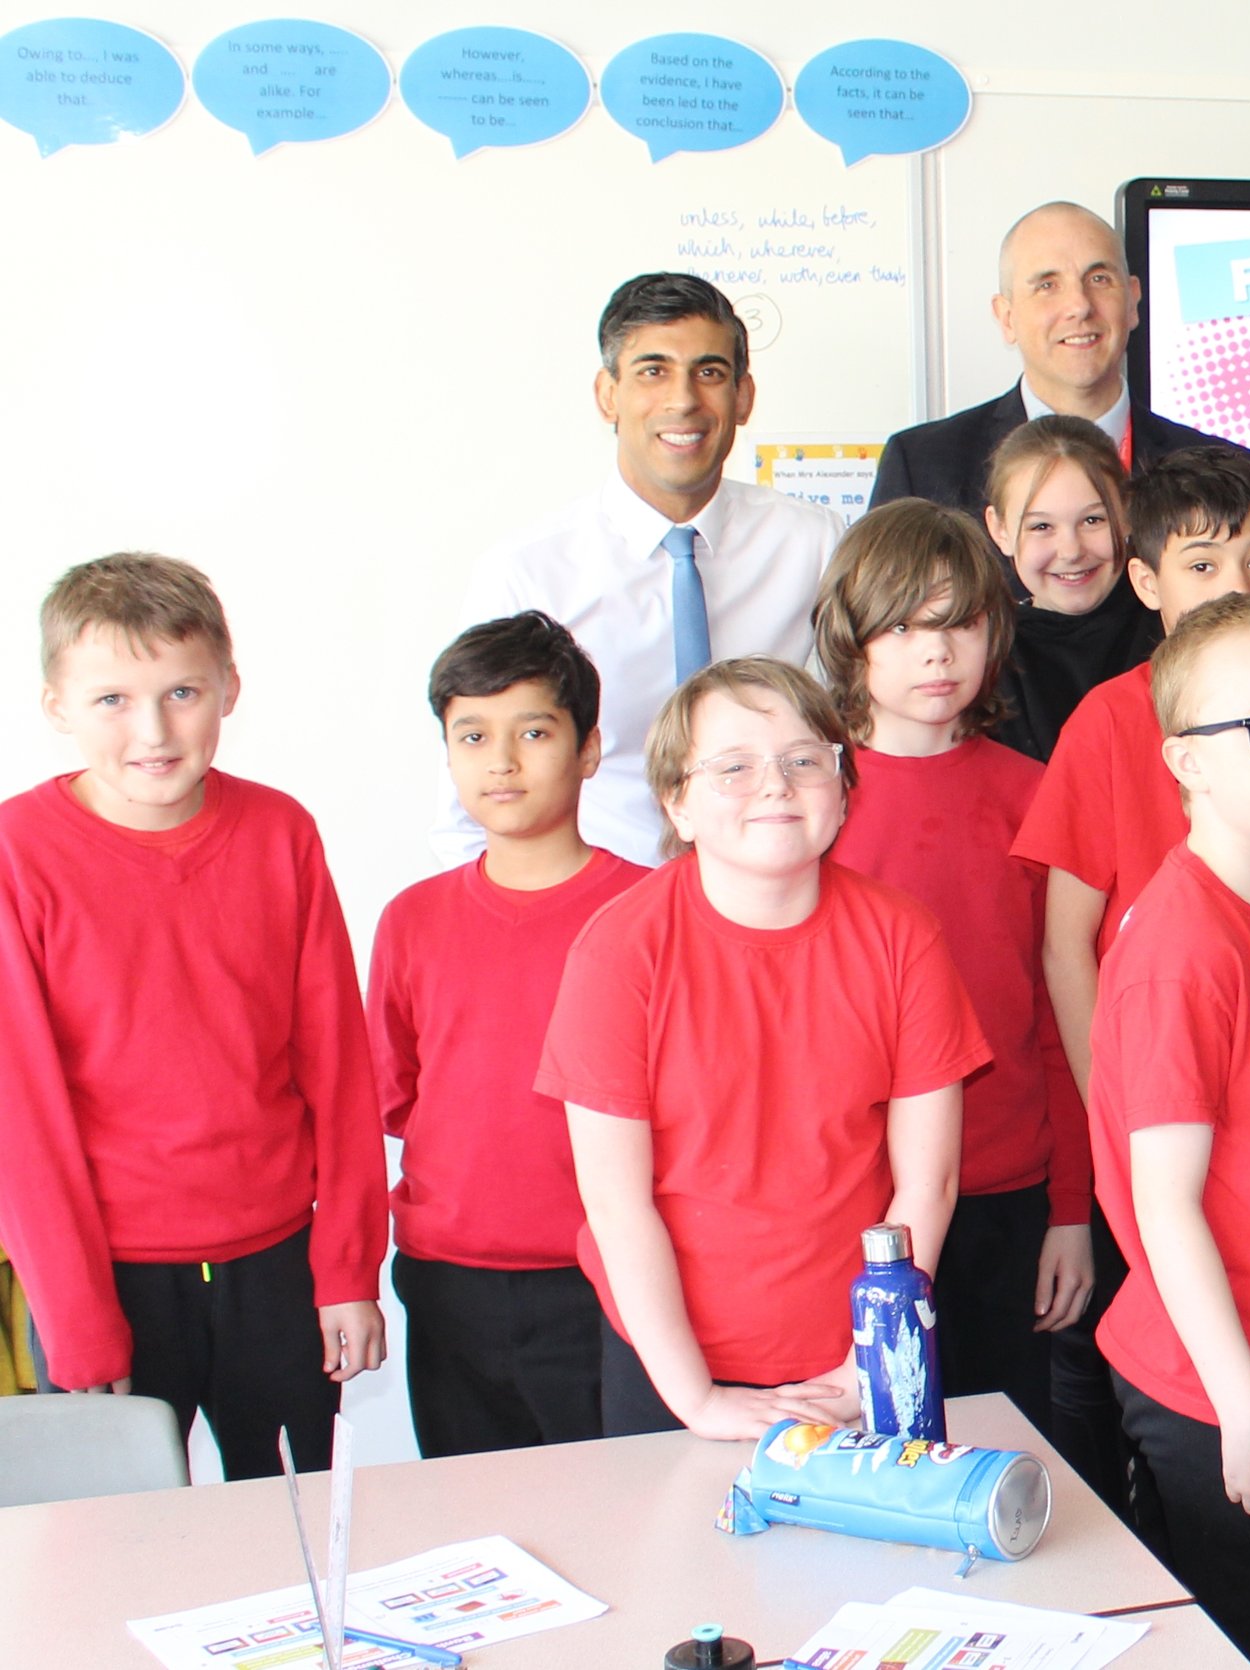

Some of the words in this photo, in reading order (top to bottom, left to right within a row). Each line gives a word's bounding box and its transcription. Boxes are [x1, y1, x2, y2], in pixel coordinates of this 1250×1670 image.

[17, 46, 64, 63] Owing
[111, 51, 140, 63] was
[228, 40, 241, 52] In
[244, 43, 283, 54] some
[286, 43, 325, 57] ways,
[461, 47, 525, 64] However,
[242, 62, 269, 76] and
[313, 65, 338, 77] are
[650, 52, 689, 66] Based
[692, 56, 709, 67] on
[712, 55, 734, 70] the
[25, 69, 57, 83] able
[60, 71, 77, 84] to
[79, 70, 133, 86] deduce
[829, 64, 892, 82] According
[894, 68, 909, 81] to
[909, 67, 932, 81] the
[258, 83, 295, 97] alike.
[299, 84, 321, 97] For
[639, 73, 702, 90] evidence,
[711, 76, 743, 91] have
[471, 93, 495, 106] can
[498, 93, 516, 107] be
[518, 96, 550, 108] seen
[836, 84, 870, 100] facts,
[872, 85, 883, 100] it
[884, 89, 906, 100] can
[908, 87, 926, 100] be
[642, 93, 675, 108] been
[677, 95, 698, 109] led
[701, 97, 716, 110] to
[717, 97, 740, 112] the
[470, 113, 486, 126] to
[635, 115, 704, 130] conclusion
[847, 108, 877, 120] seen
[680, 206, 746, 232] unless,
[822, 202, 878, 230] before,
[677, 236, 743, 261] which,
[750, 238, 841, 264] wherever,
[825, 269, 861, 285] even
[744, 307, 764, 333] 3
[786, 491, 830, 504] ve
[841, 494, 864, 504] me
